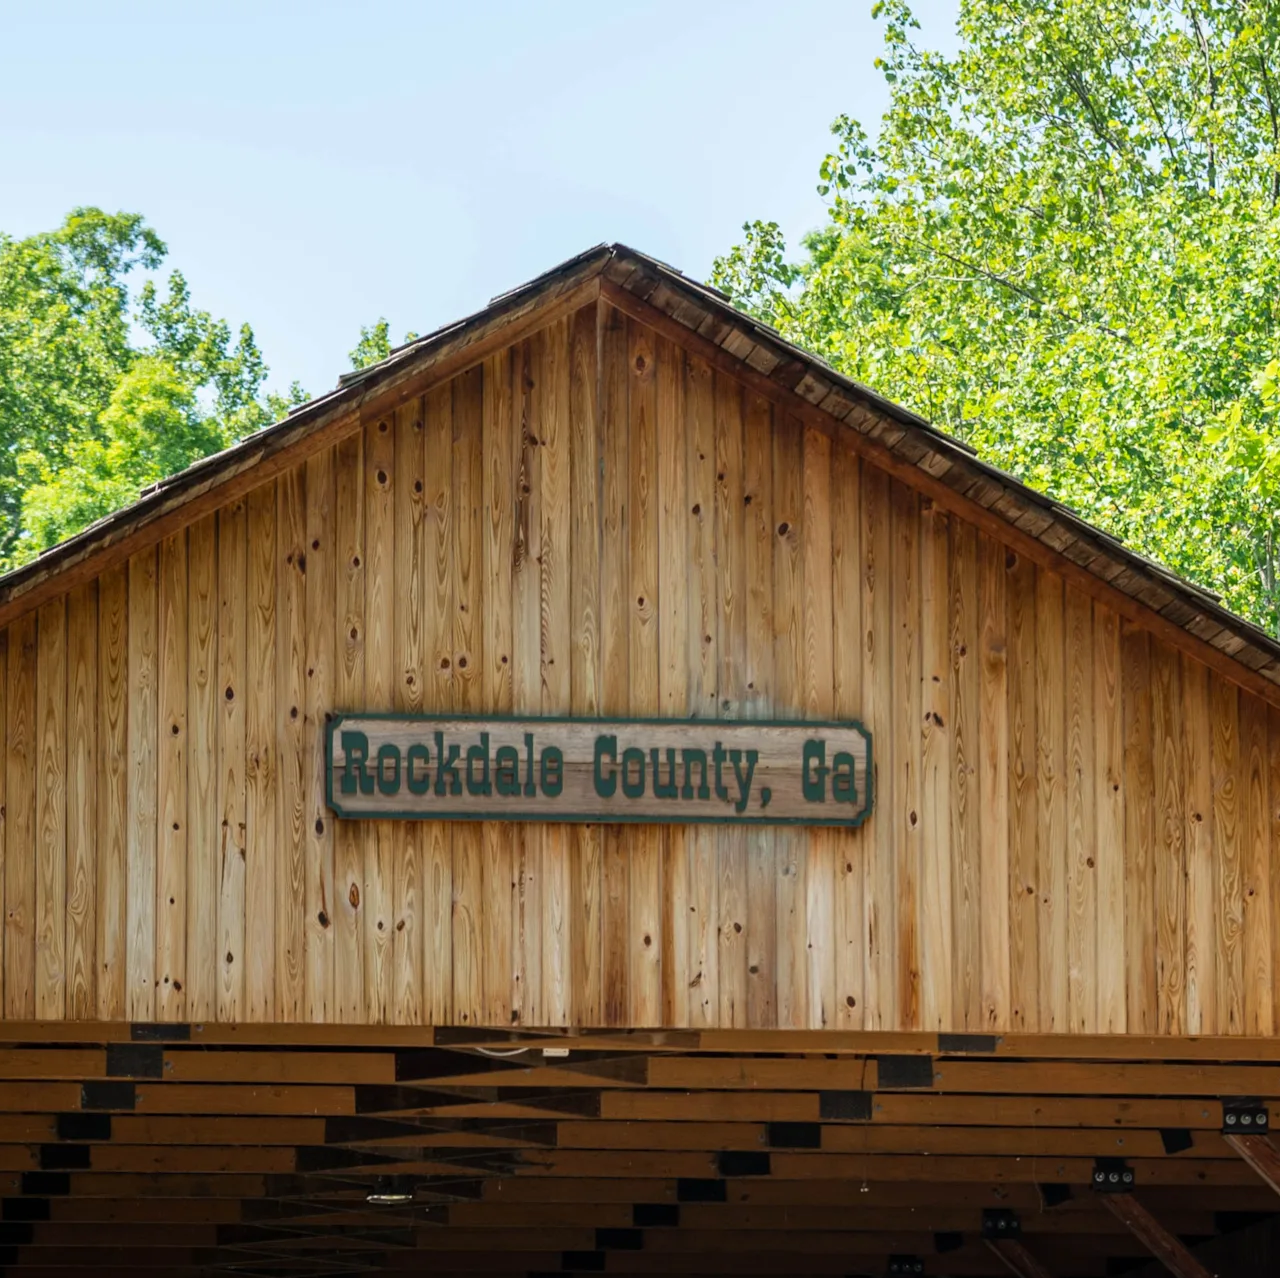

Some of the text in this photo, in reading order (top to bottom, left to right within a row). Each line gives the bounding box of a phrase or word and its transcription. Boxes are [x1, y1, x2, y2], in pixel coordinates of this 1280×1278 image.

[340, 730, 859, 813] Rockdale County, Ga
